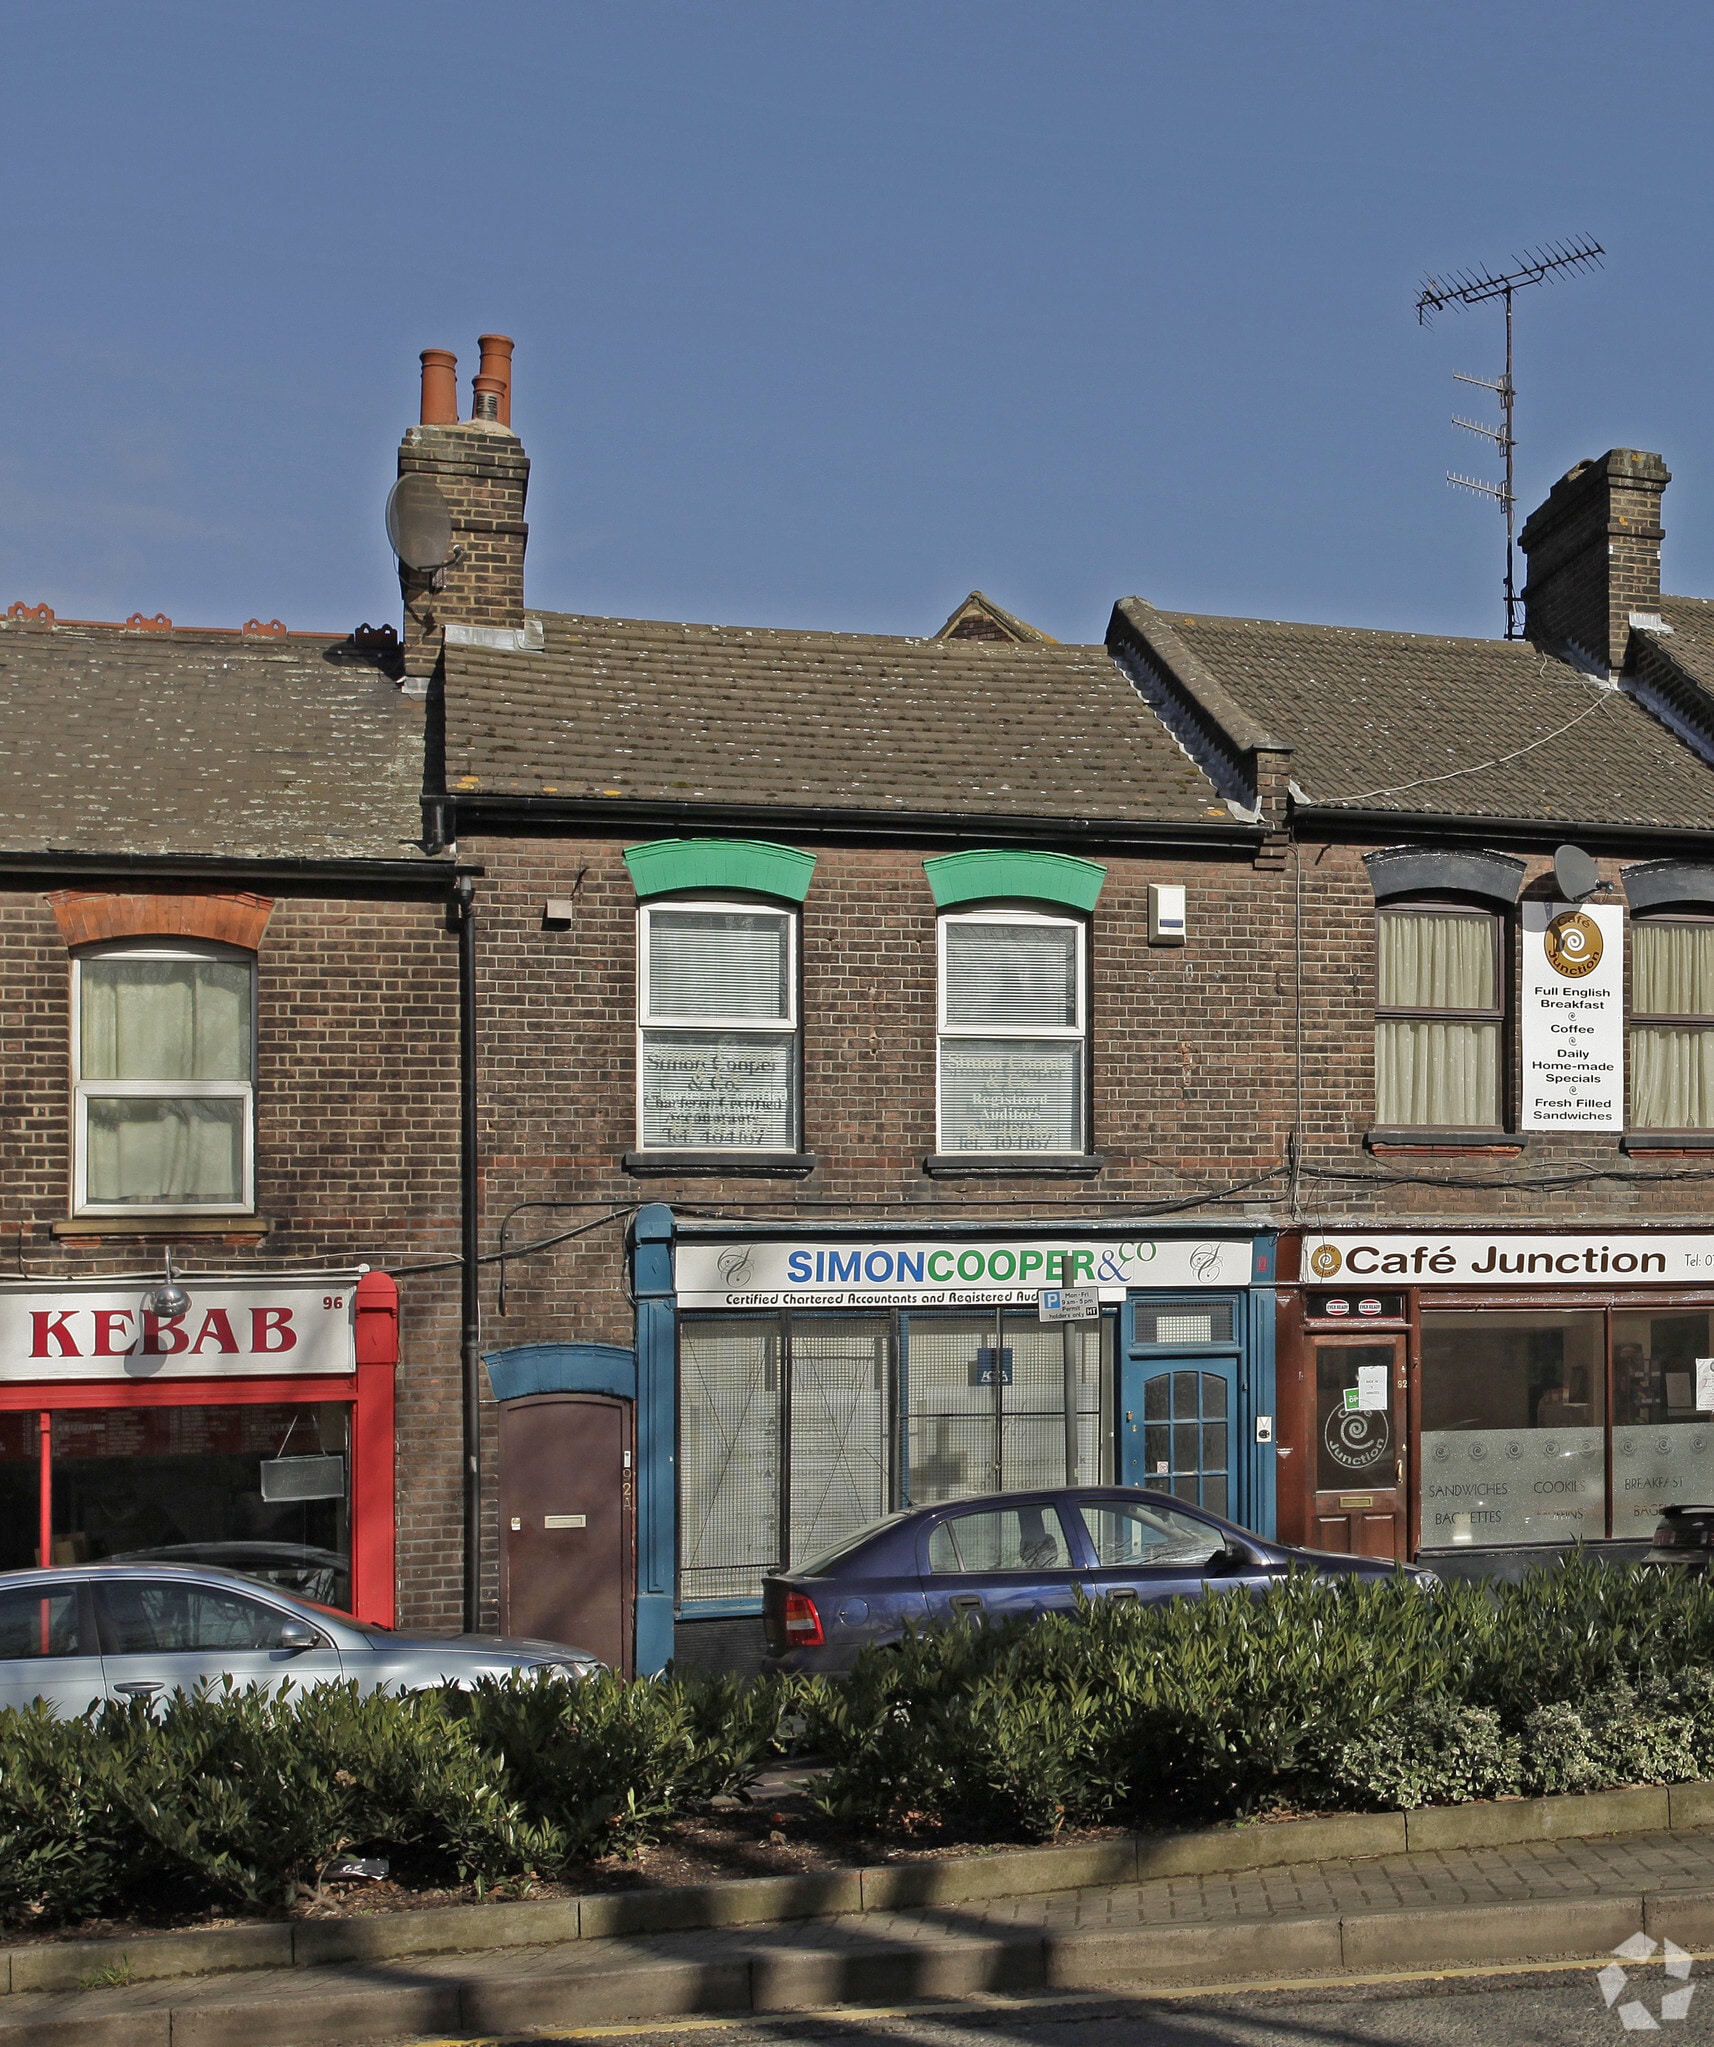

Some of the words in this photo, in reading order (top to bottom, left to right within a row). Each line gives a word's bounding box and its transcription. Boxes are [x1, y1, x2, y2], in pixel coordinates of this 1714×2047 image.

[1557, 915, 1590, 929] Café
[1548, 950, 1600, 975] Junction
[1534, 986, 1558, 996] Full
[1562, 987, 1611, 999] English
[1540, 999, 1605, 1010] Breakfast
[1550, 1024, 1595, 1034] Coffee
[1557, 1049, 1590, 1060] Daily
[1532, 1060, 1615, 1071] Home-made
[1545, 1073, 1602, 1084] Specials
[972, 1092, 1048, 1107] Registered
[1535, 1098, 1572, 1107] Fresh
[1576, 1099, 1612, 1108] Filled
[980, 1107, 1041, 1121] Auditors
[1533, 1110, 1613, 1121] Sandwiches
[1345, 1244, 1457, 1275] Café
[1471, 1245, 1667, 1275] Junction
[1684, 1253, 1701, 1267] Tel:
[1705, 1253, 1714, 1267] 0
[322, 1296, 343, 1310] 96
[725, 1294, 779, 1305] Certified
[782, 1293, 844, 1305] Chartered
[848, 1293, 917, 1304] Accountants
[921, 1292, 945, 1304] and
[949, 1291, 1012, 1304] Registered
[28, 1306, 298, 1359] KEBAB
[1397, 1380, 1408, 1389] 92
[1329, 1438, 1385, 1465] Junction
[1428, 1483, 1508, 1498] SANDWICHES
